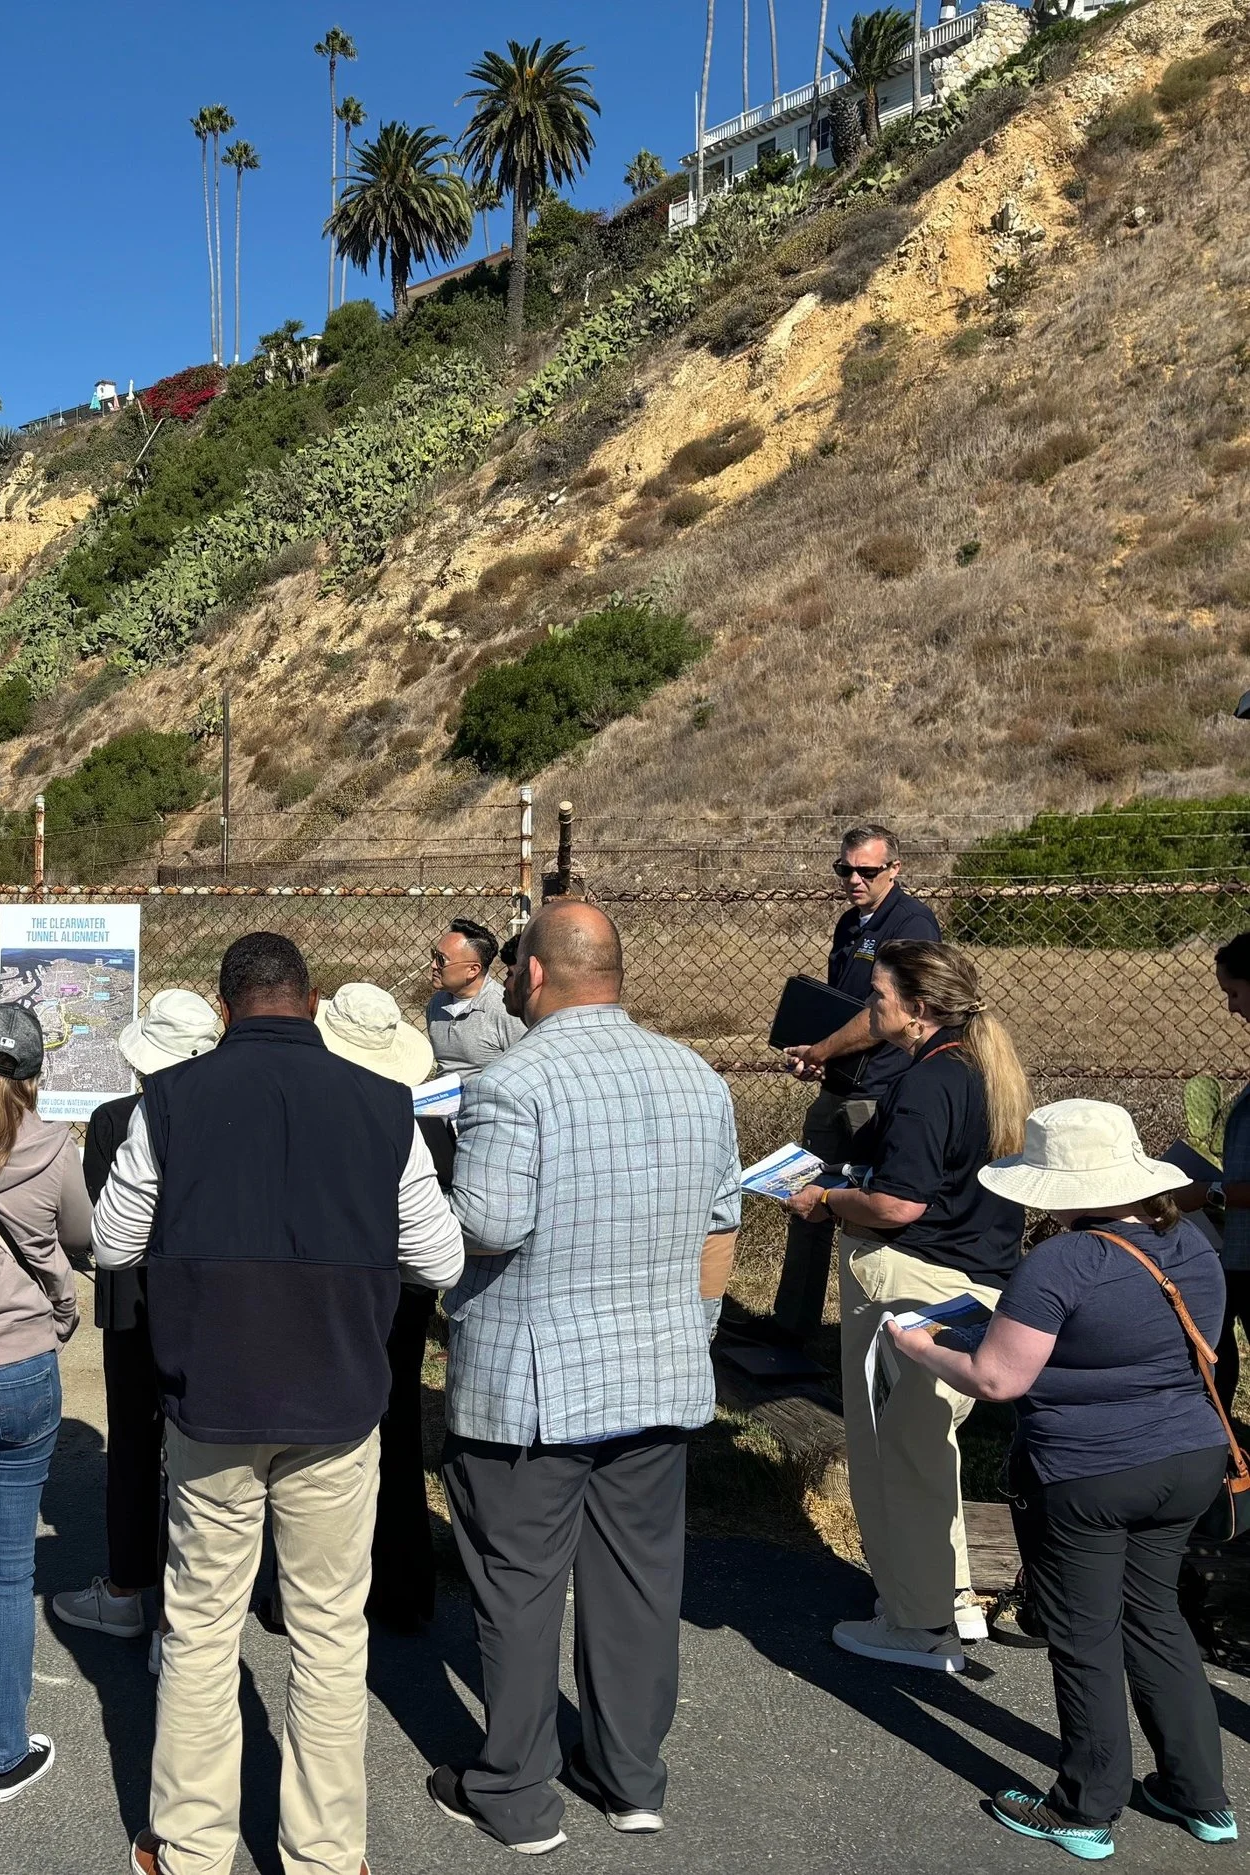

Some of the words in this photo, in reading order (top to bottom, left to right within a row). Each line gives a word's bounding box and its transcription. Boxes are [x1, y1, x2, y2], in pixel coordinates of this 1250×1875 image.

[31, 917, 48, 929] THE
[49, 917, 106, 929] CLEARWATER
[26, 930, 59, 942] TUNNEL
[60, 930, 110, 943] ALIGNMENT
